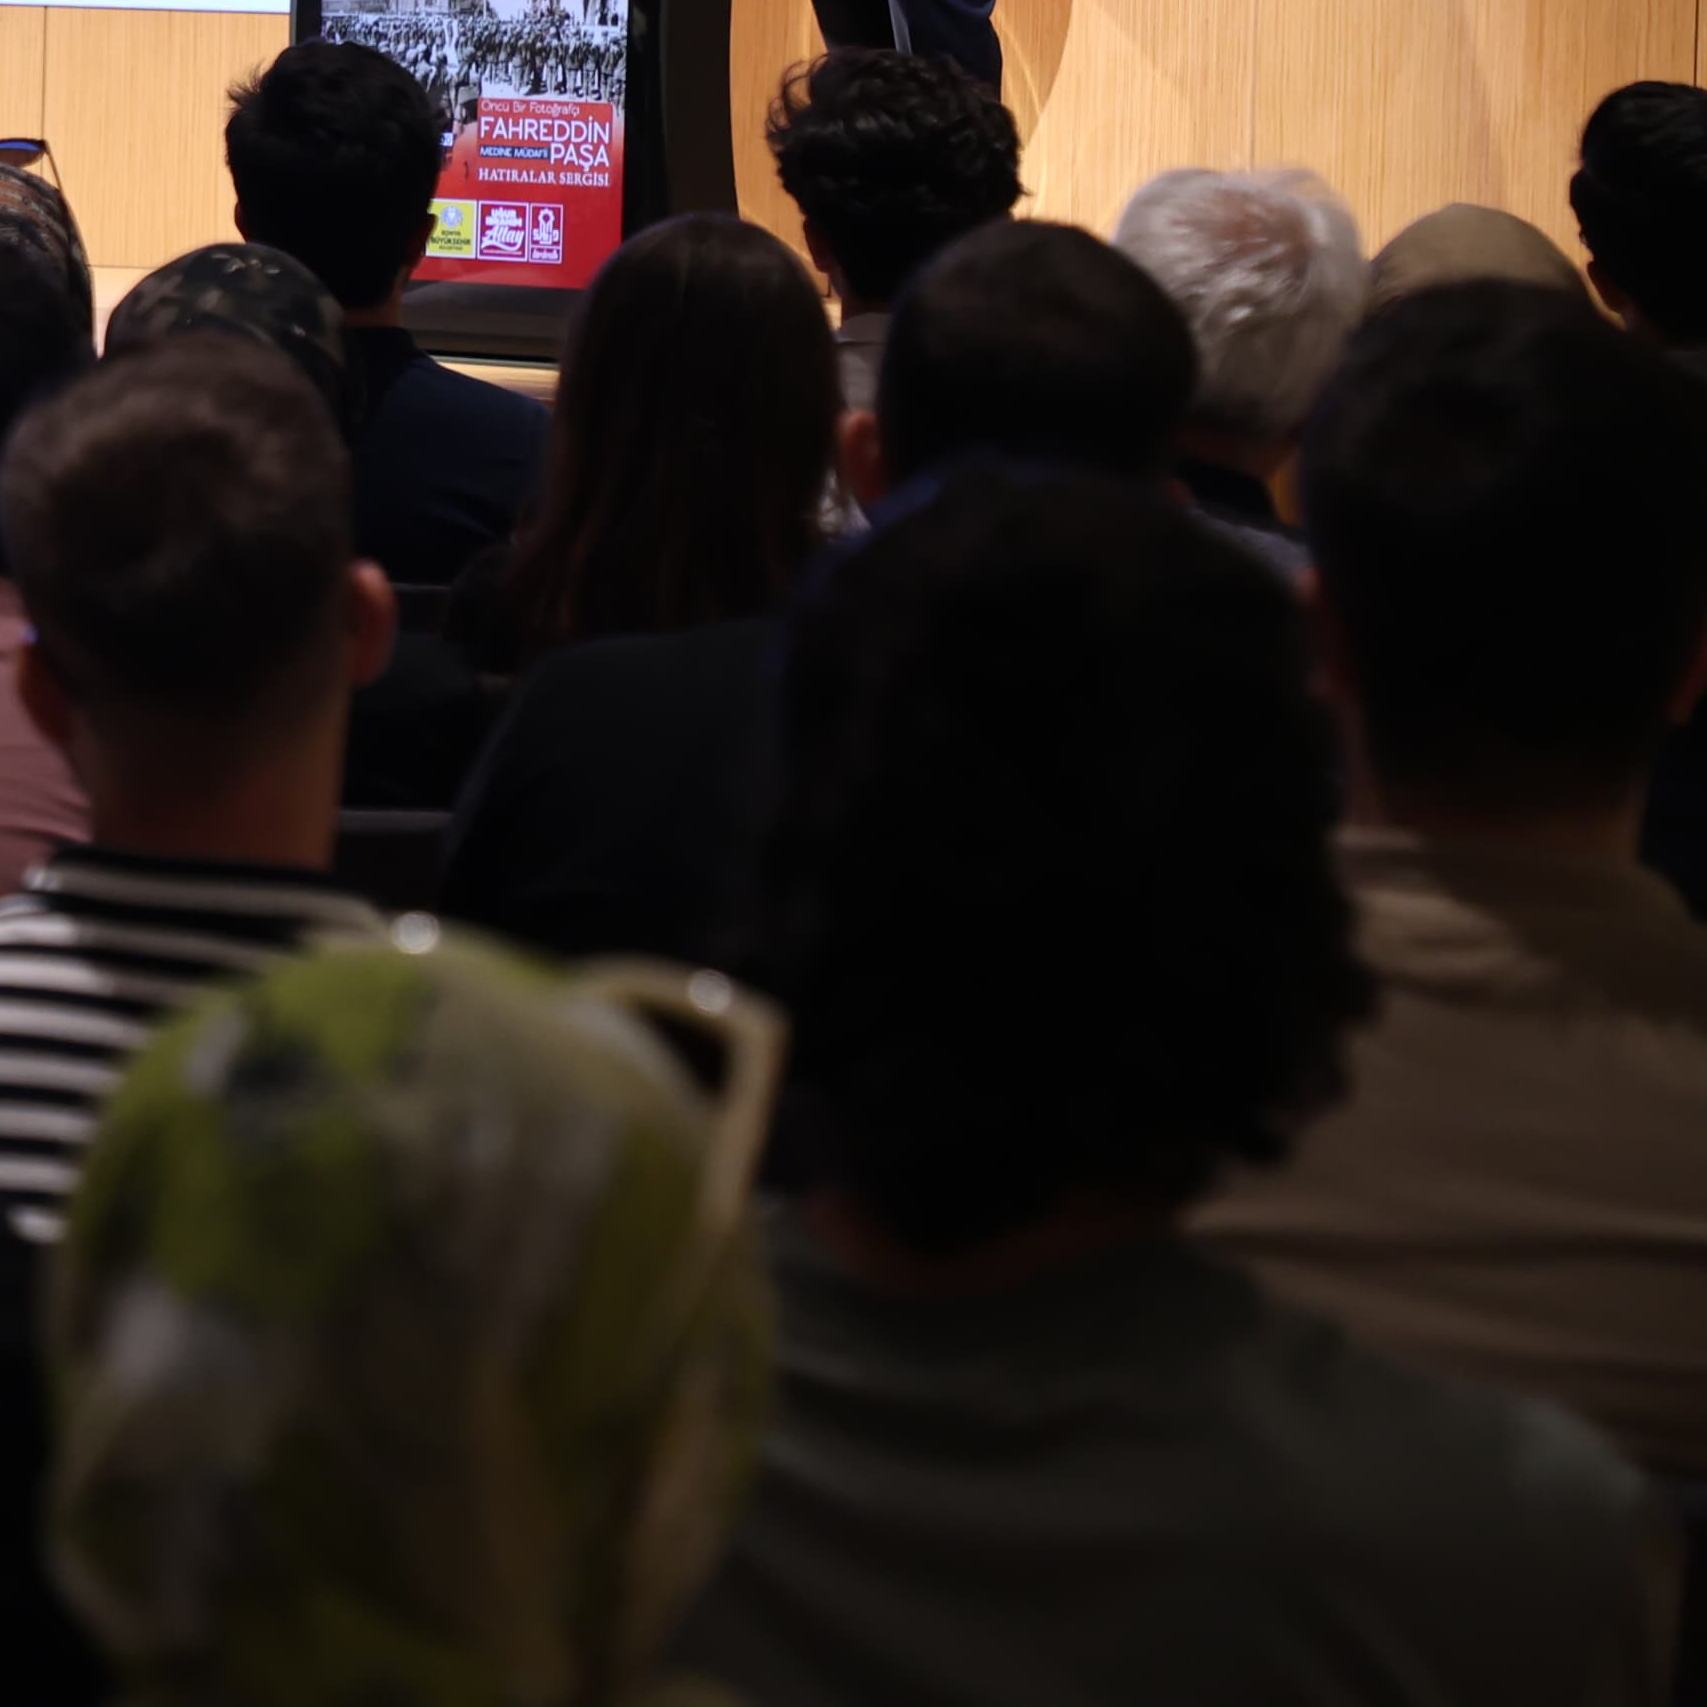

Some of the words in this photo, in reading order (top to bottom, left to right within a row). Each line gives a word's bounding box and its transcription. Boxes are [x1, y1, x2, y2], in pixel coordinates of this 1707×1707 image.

[512, 101, 526, 112] Bir
[479, 115, 610, 144] FAHREDDİN
[549, 142, 610, 172] PAŞA
[478, 168, 557, 185] HATIRALAR
[558, 172, 610, 187] SERGİSİ
